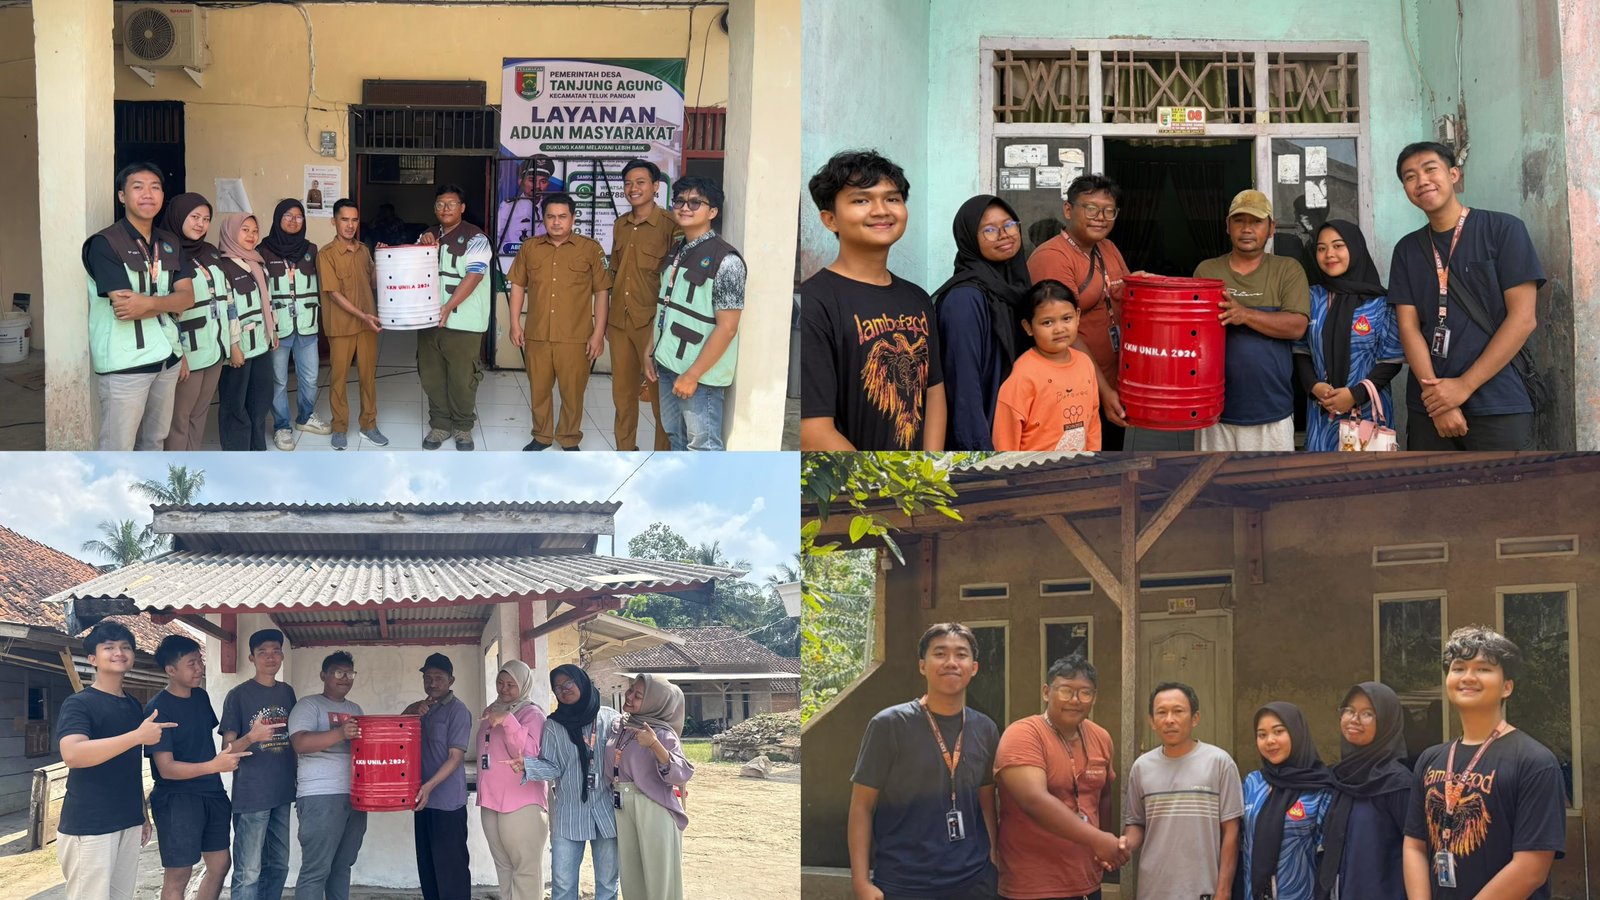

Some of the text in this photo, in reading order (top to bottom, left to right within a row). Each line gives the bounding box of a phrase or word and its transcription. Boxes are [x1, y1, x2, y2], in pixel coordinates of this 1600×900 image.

[550, 80, 663, 92] TANJUNG AGUNG
[532, 106, 656, 123] LAYANAN
[510, 126, 676, 140] ADUAN MASYARAKAT
[1140, 346, 1168, 356] UNILA
[1172, 349, 1196, 358] 2026
